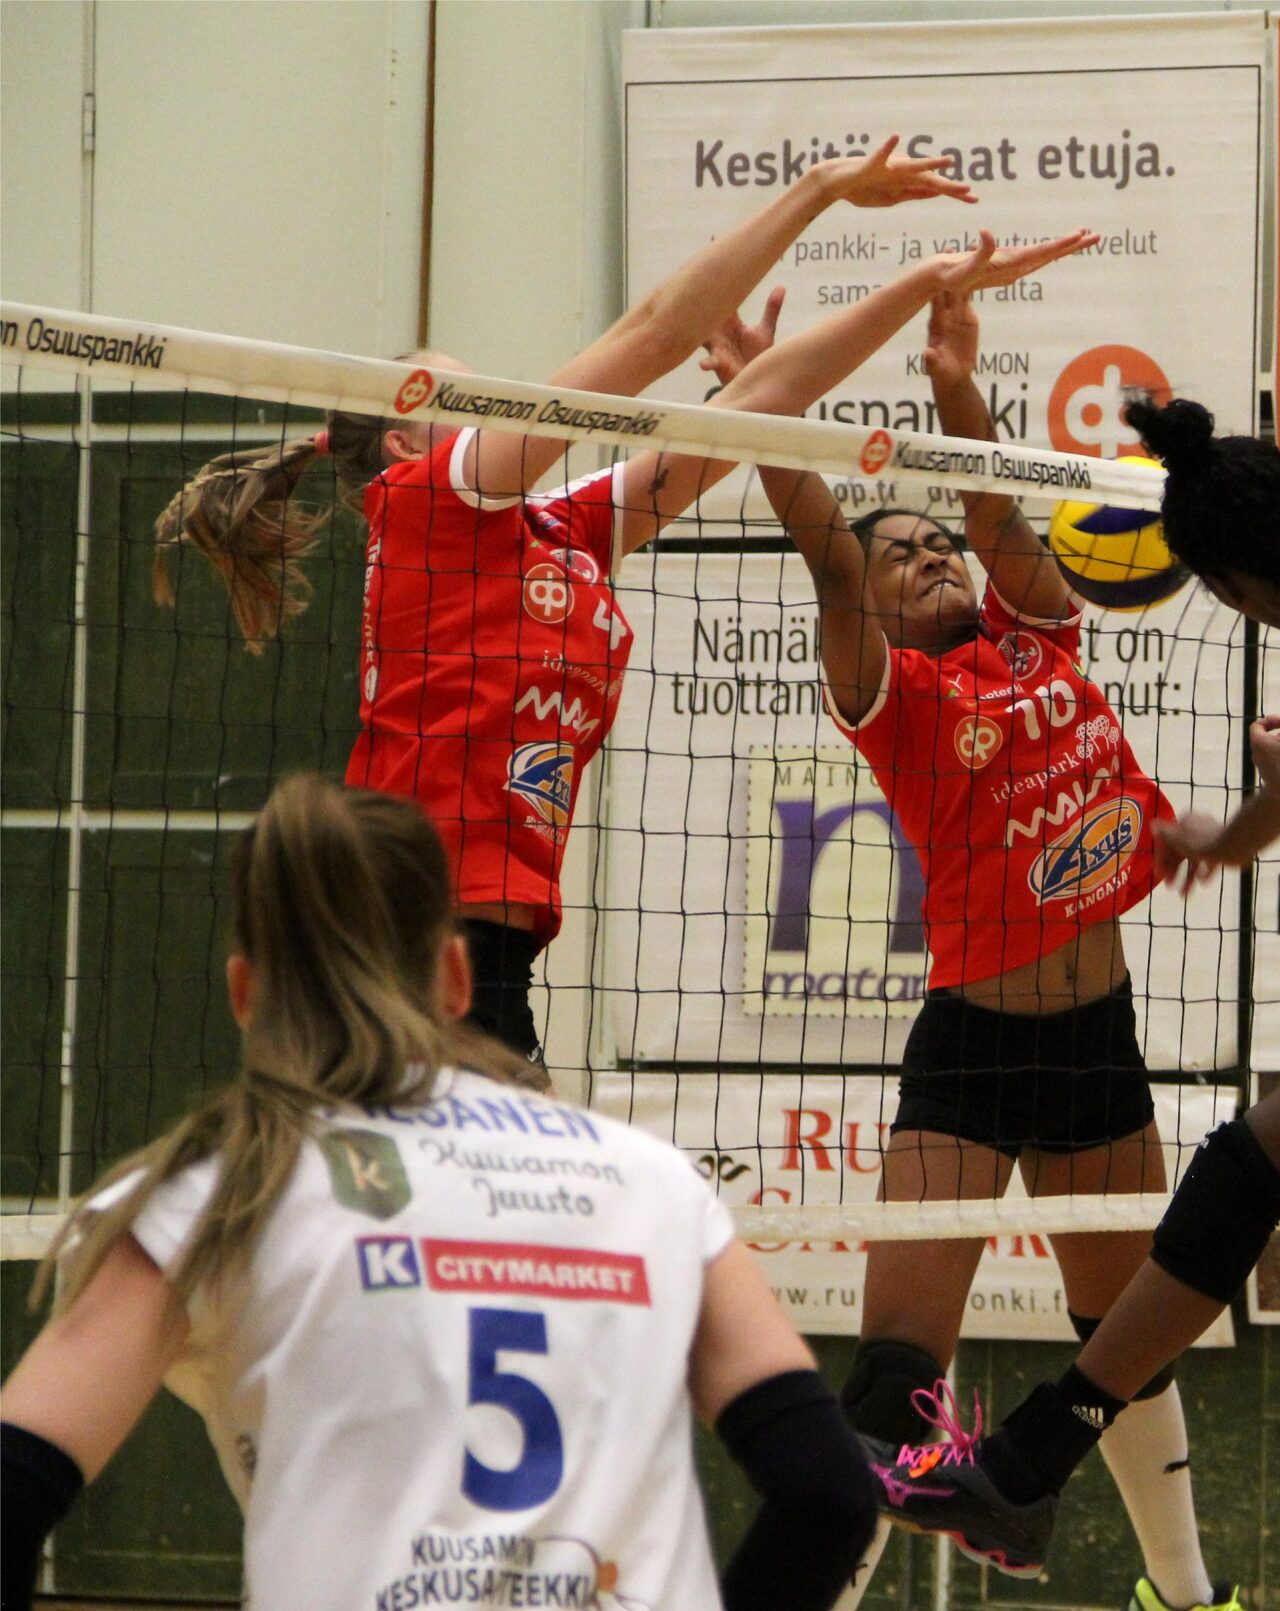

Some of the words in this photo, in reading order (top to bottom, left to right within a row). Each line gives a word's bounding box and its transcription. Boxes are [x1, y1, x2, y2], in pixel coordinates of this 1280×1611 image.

[1037, 129, 1176, 190] etuja.
[795, 233, 890, 266] pankki-
[898, 232, 922, 264] ja
[26, 317, 168, 369] Osuuspankki
[428, 382, 536, 419] Kuusamon
[894, 440, 985, 476] Kuusamon
[992, 449, 1091, 490] Osuuspankki
[592, 596, 628, 651] 4
[1116, 626, 1164, 663] on
[990, 751, 1080, 805] ideapark
[420, 1137, 628, 1188] Kuusamon
[472, 1177, 595, 1217] Juusto
[435, 1256, 634, 1294] CITYMARKET
[460, 1306, 565, 1513] 5
